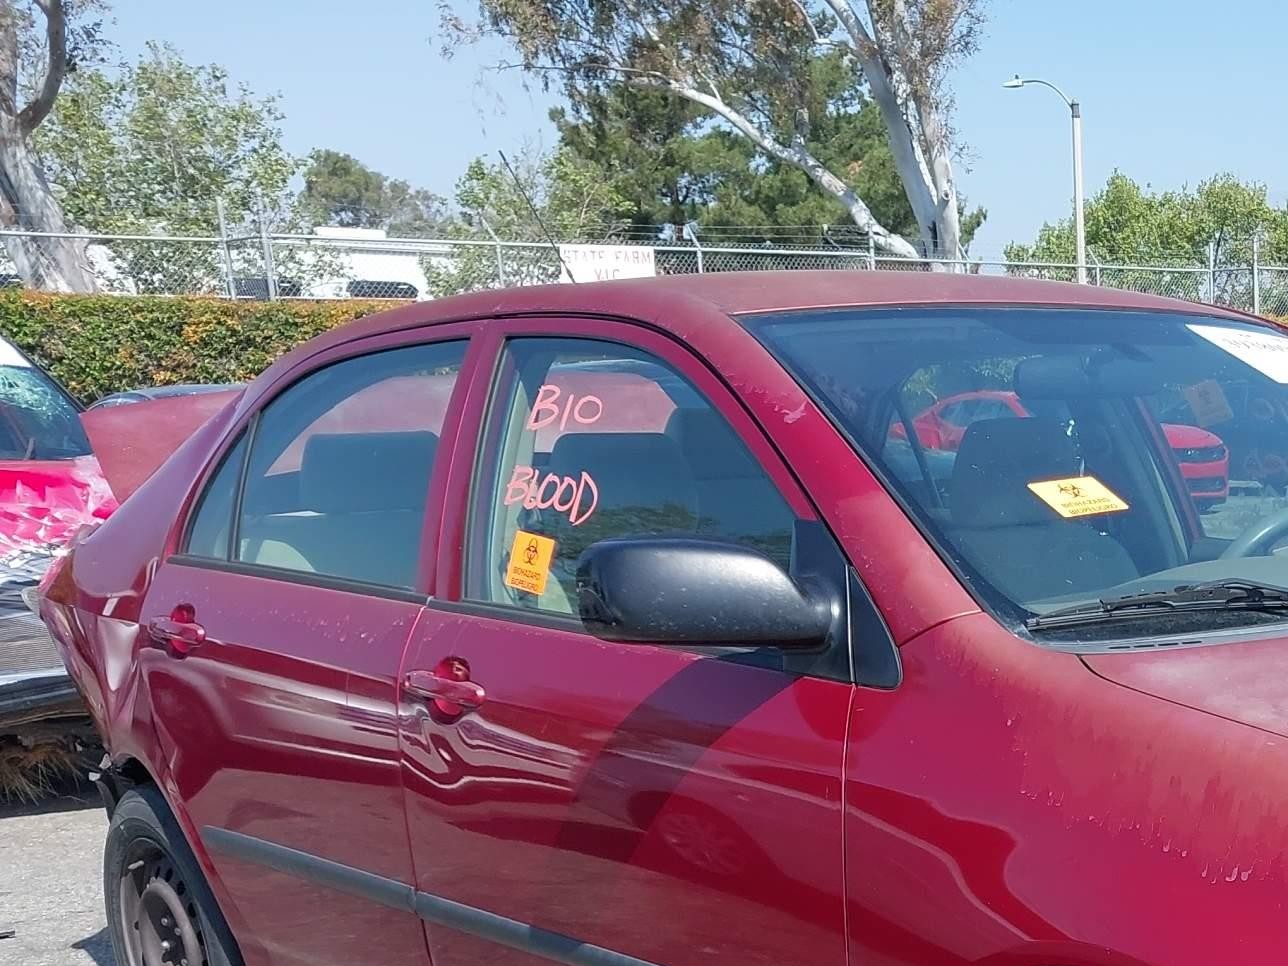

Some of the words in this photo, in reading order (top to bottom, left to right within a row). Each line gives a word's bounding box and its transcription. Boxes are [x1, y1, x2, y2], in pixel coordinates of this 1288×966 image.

[563, 248, 605, 264] STATE
[614, 249, 651, 265] FARM
[526, 384, 603, 431] BIO
[503, 464, 598, 526] BLOOD
